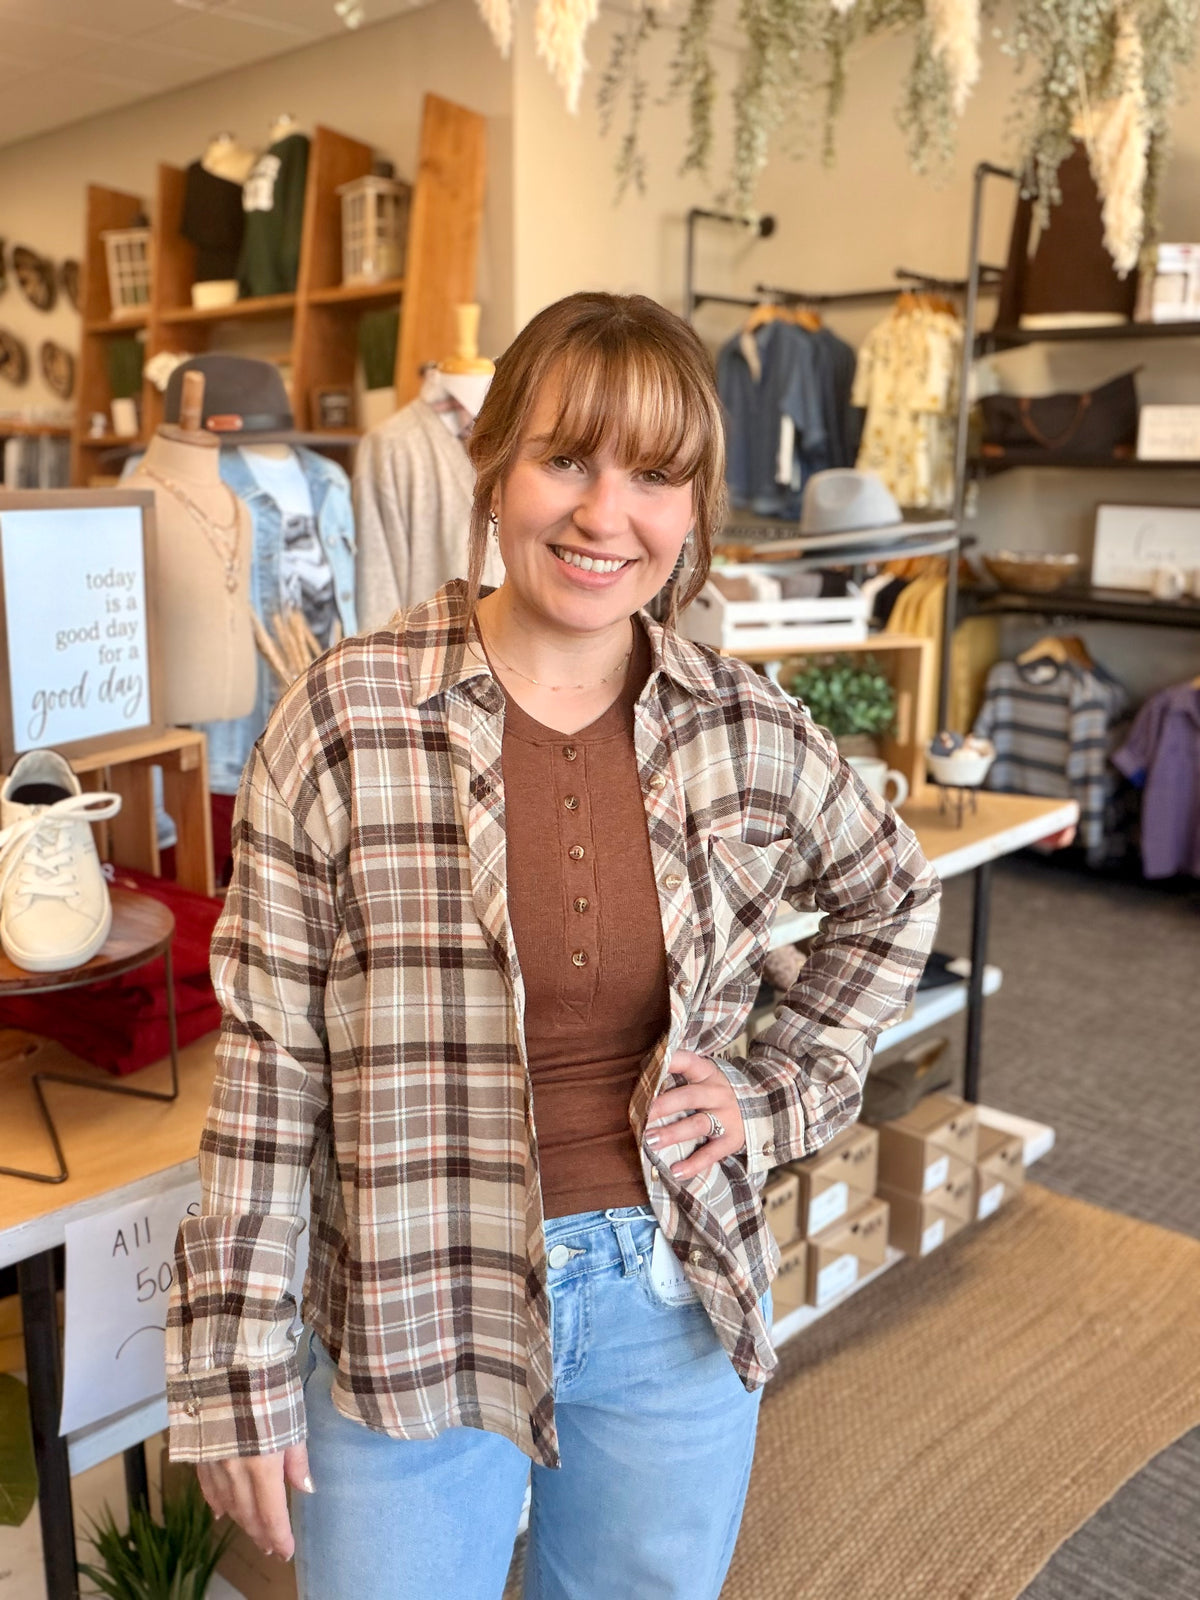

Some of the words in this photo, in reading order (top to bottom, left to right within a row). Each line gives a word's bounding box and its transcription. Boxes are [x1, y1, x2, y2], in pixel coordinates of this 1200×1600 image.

[86, 568, 136, 590] today
[106, 595, 121, 613] is
[127, 597, 138, 611] a
[56, 622, 100, 651] good
[107, 619, 139, 640] day
[99, 645, 124, 665] for
[129, 646, 140, 660] a
[28, 671, 89, 741] good
[99, 667, 144, 718] day
[112, 1216, 151, 1256] All
